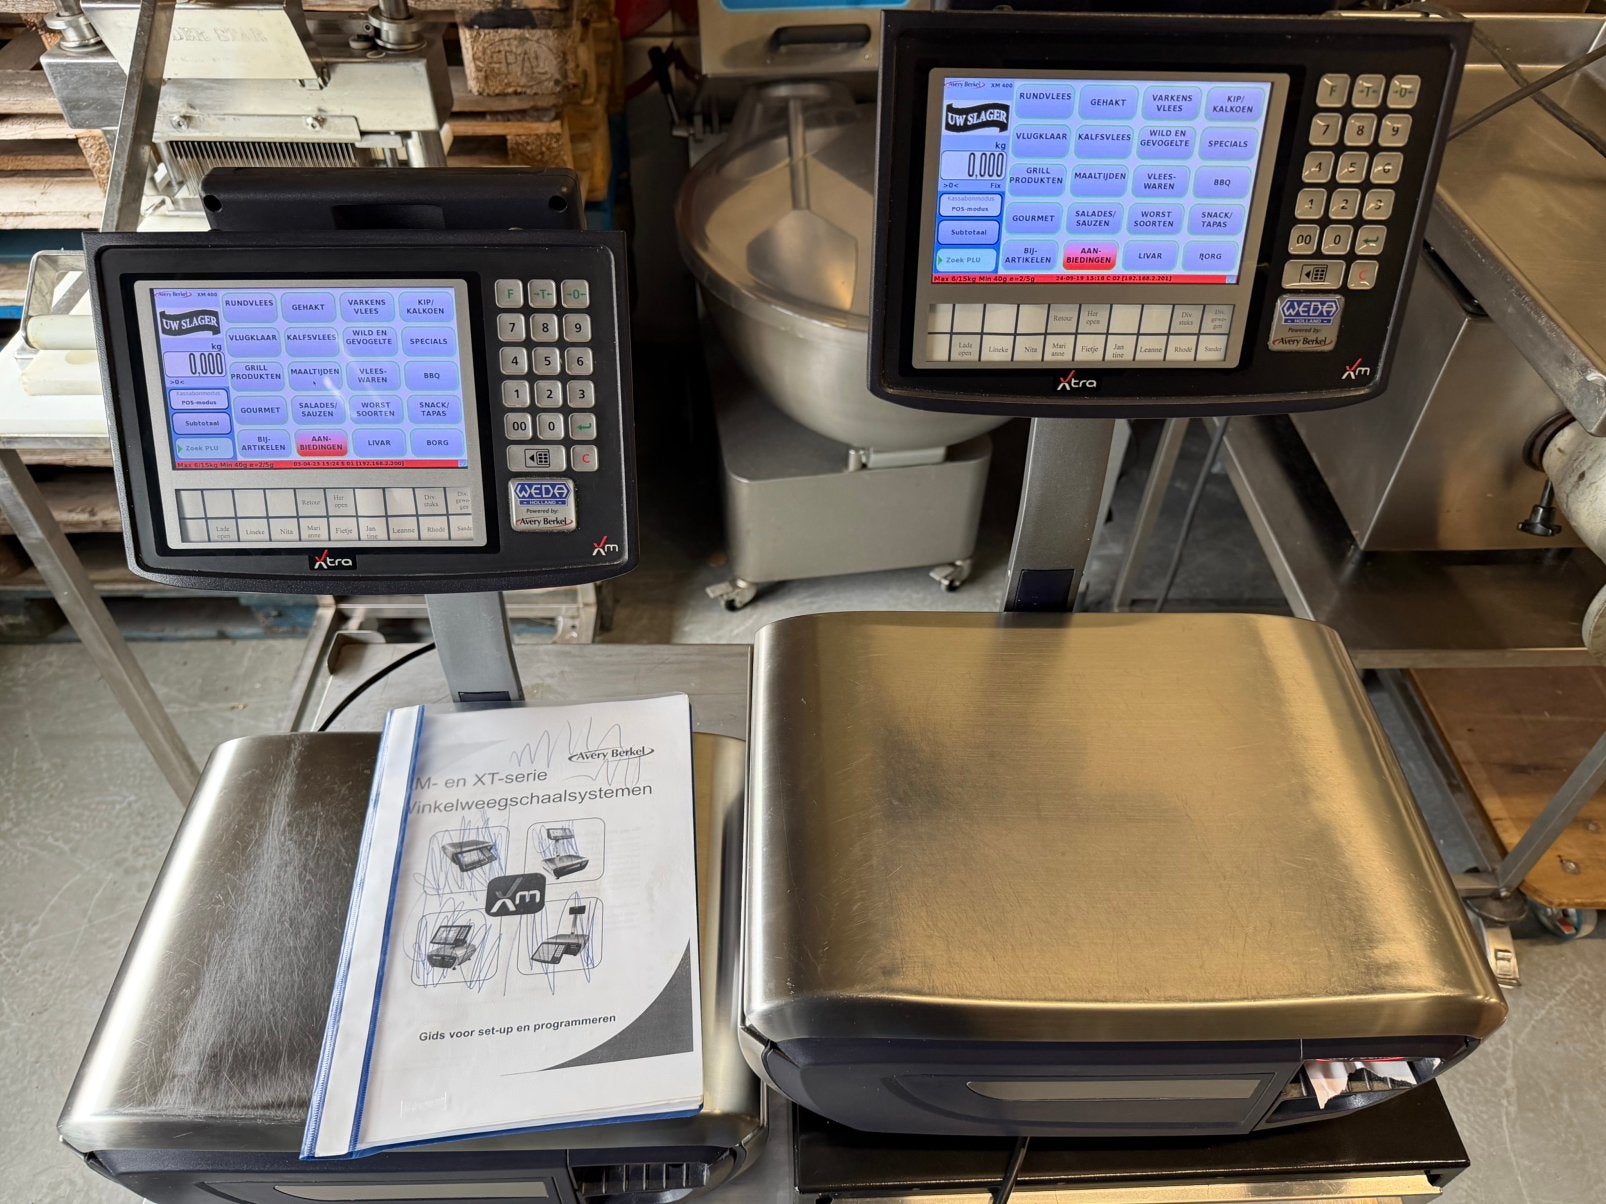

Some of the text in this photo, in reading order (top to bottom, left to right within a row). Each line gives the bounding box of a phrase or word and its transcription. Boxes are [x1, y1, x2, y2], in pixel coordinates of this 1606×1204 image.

[1019, 92, 1072, 100] RUNDVLEES
[1152, 94, 1193, 102] VARKENS
[1226, 95, 1245, 103] KIP/
[1156, 104, 1183, 112] VLEES
[1212, 105, 1253, 113] KALKOEN
[947, 109, 1008, 126] UW SLAGER
[1150, 129, 1186, 137] WILD EN
[1322, 124, 1365, 136] 7 8
[1016, 132, 1067, 140] VLUGKLAAR
[1078, 133, 1131, 141] KALFSVLEES
[995, 141, 1006, 150] kg
[1140, 139, 1190, 147] GEVOGELTE
[1208, 140, 1248, 148] SPECIALS
[1009, 176, 1063, 184] PRODUKTEN
[1074, 172, 1126, 181] MAALTIJDEN
[1213, 179, 1231, 187] BBQ
[1075, 210, 1116, 218] SALADES/
[1076, 219, 1110, 227] SAUZEN
[1296, 234, 1341, 245] 00 0
[1023, 247, 1038, 255] BIJ-
[1004, 256, 1051, 264] ARTIKELEN
[1066, 256, 1111, 264] BIEDINGEN
[1138, 252, 1162, 260] LIVAR
[507, 288, 514, 299] F
[224, 299, 274, 307] RUNDVLEES
[1282, 302, 1337, 317] WEDA
[162, 314, 218, 331] UW SLAGER
[1086, 318, 1100, 326] open
[508, 322, 582, 333] 7 8 9
[1278, 336, 1327, 346] Avery Berkel
[211, 343, 222, 352] kg
[511, 356, 584, 366] 4 5 6
[290, 368, 340, 376] MAALTIJDEN
[423, 372, 440, 380] BBQ
[1056, 369, 1097, 391] Xtra
[546, 389, 585, 399] 2 3
[298, 401, 337, 409] SALADES/
[361, 401, 391, 409] WORST
[419, 401, 450, 409] SNACK/
[512, 421, 555, 431] 00 0
[257, 436, 271, 444] BIJ-
[582, 454, 591, 464] C
[515, 484, 568, 498] WEDA
[520, 517, 567, 527] Avery Berkel
[314, 549, 352, 569] Xtra
[576, 746, 646, 761] Avery Berkel
[444, 777, 466, 789] en
[472, 768, 548, 787] XT-serie
[418, 1013, 616, 1042] Gids voor set-up en programmeren
